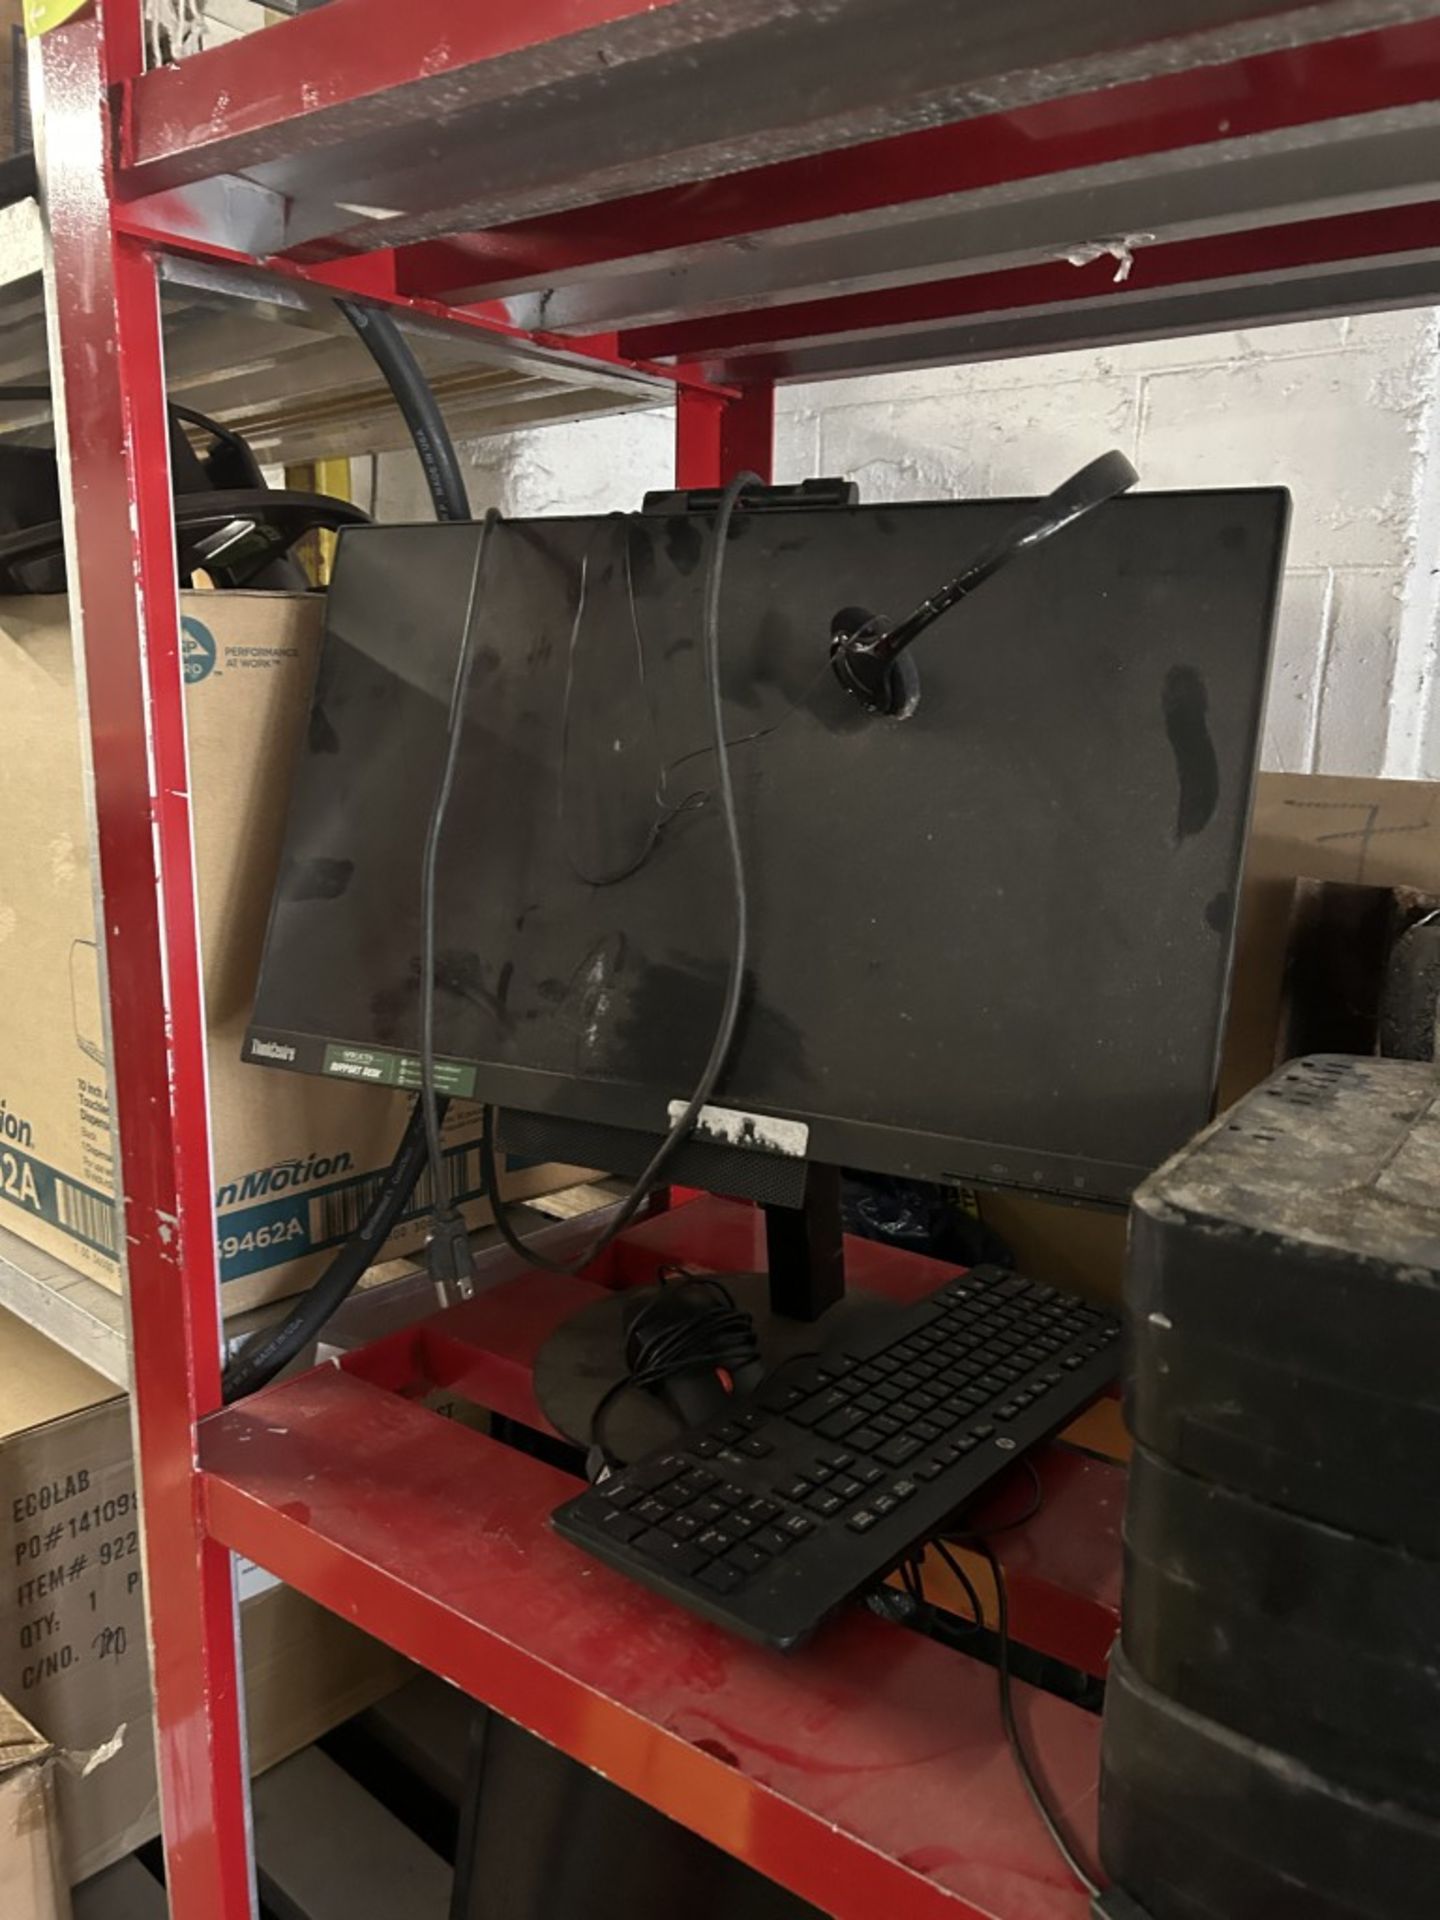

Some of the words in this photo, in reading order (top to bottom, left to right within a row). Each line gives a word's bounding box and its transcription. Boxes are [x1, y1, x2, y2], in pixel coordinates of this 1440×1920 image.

[224, 646, 299, 657] PERFORMANCE
[226, 659, 238, 668] AT
[0, 1153, 41, 1210] 2A
[13, 1469, 90, 1523] ECOLAB
[18, 1554, 88, 1608] ITEM#
[100, 1531, 137, 1566] 922
[20, 1611, 61, 1649] QTY:
[89, 1590, 97, 1611] 1
[22, 1644, 79, 1690] C/NO.
